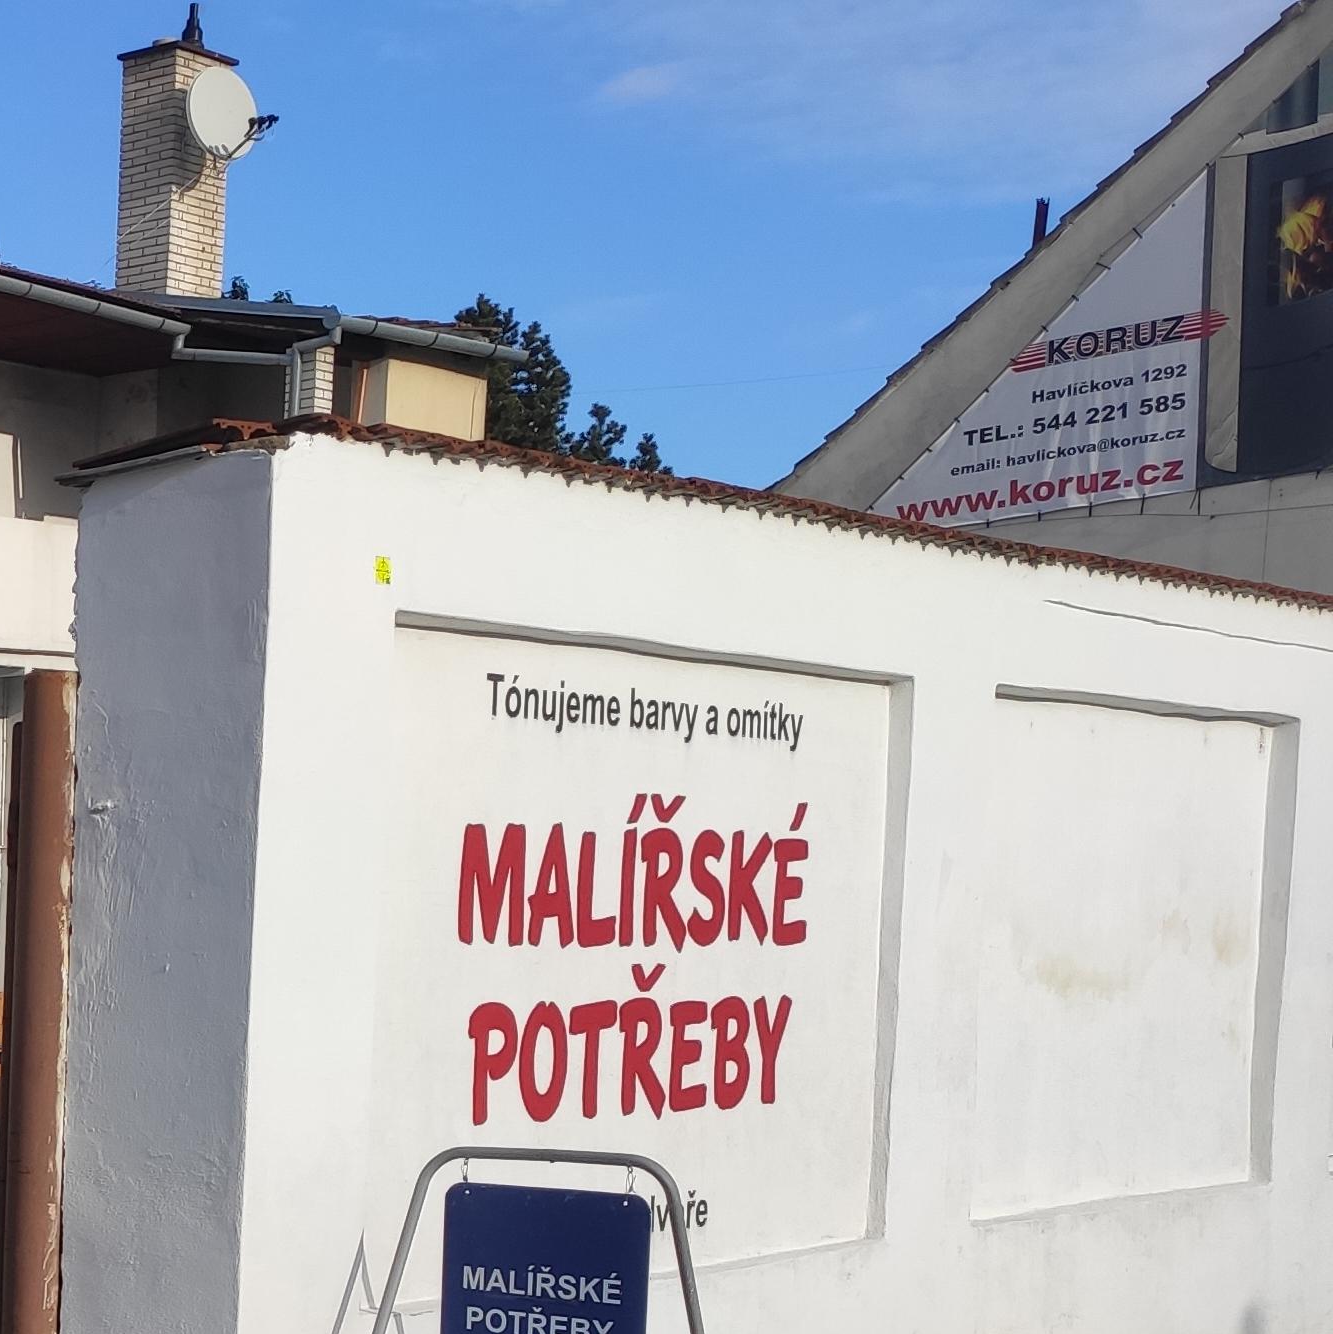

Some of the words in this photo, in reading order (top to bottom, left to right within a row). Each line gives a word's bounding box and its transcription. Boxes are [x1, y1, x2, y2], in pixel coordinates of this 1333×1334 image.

[1046, 313, 1186, 366] KORUZ
[1140, 363, 1188, 384] 1292
[963, 423, 1025, 448] TEL.:
[1032, 411, 1078, 436] 544
[1085, 402, 1129, 426] 221
[1138, 392, 1187, 418] 585
[950, 455, 1002, 478] email:
[1006, 426, 1186, 470] havlickova@koruz.cz
[896, 459, 1184, 522] www.koruz.cz
[485, 672, 622, 731] Tónujeme
[628, 686, 700, 743] barvy
[704, 704, 719, 734] a
[726, 695, 804, 752] omítky
[458, 792, 810, 952] MALÍŘSKÉ
[467, 962, 793, 1127] POTŘEBY
[461, 1264, 622, 1305] MALÍŘSKÉ
